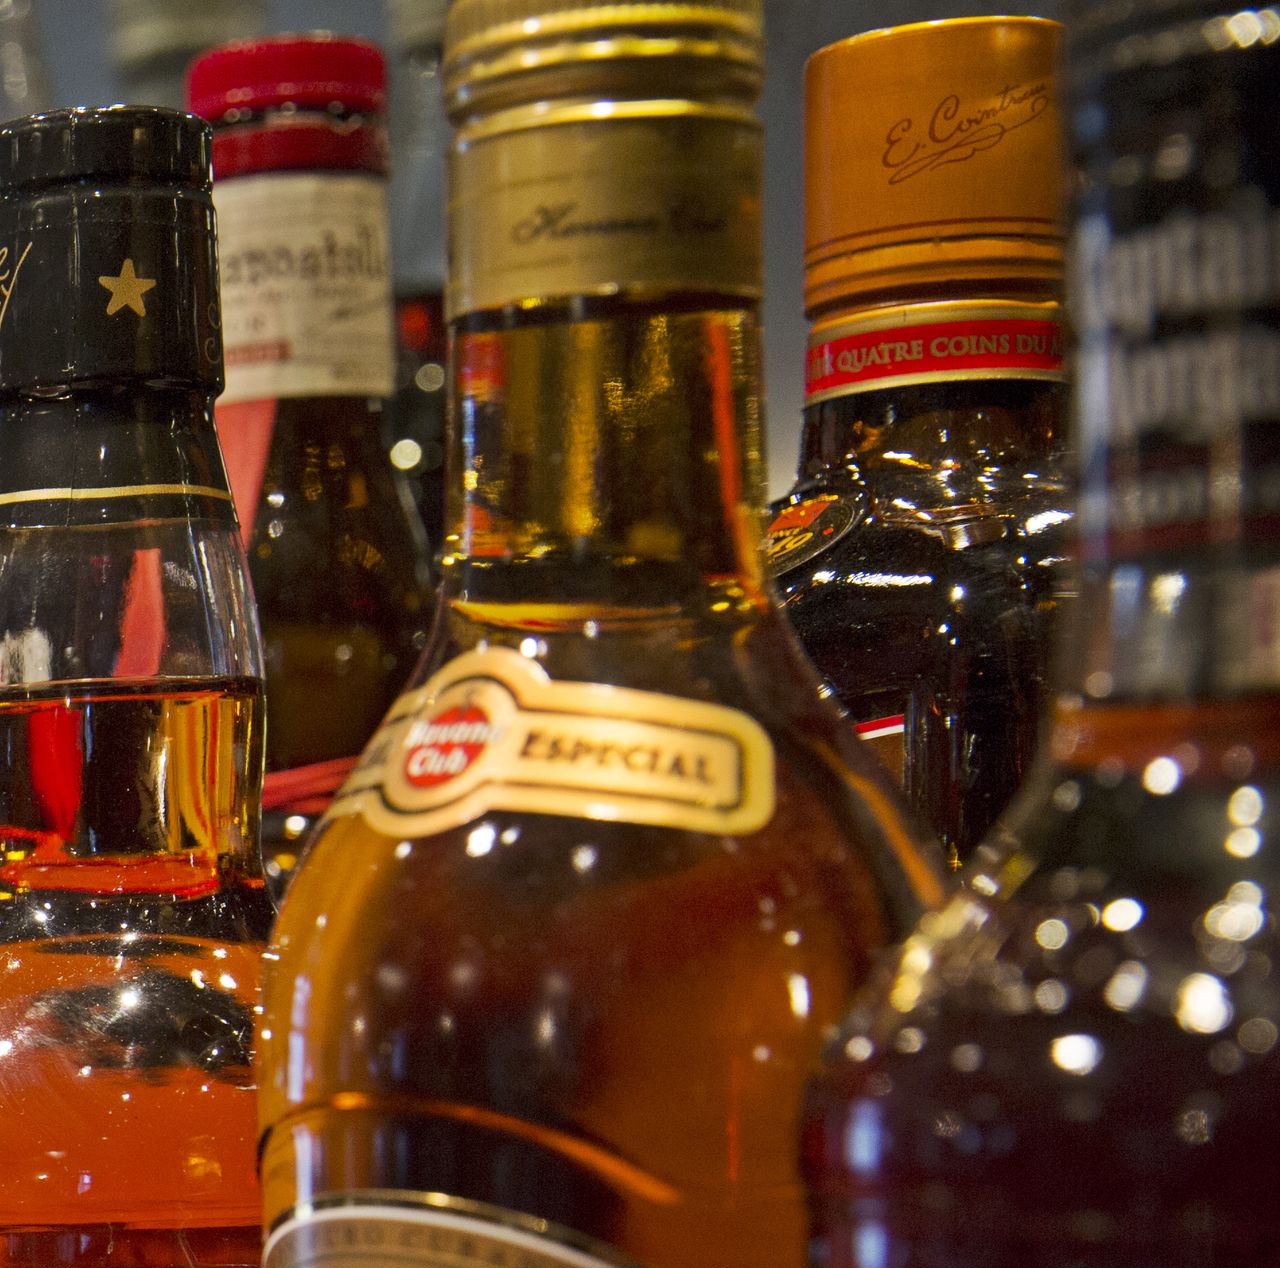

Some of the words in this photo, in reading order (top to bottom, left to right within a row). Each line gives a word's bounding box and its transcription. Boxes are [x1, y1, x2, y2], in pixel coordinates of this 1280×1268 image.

[836, 339, 924, 374] QUATRE
[931, 334, 1010, 358] COINS
[1017, 333, 1048, 356] DU
[407, 746, 467, 777] Club
[519, 730, 717, 786] ESPECIAL
